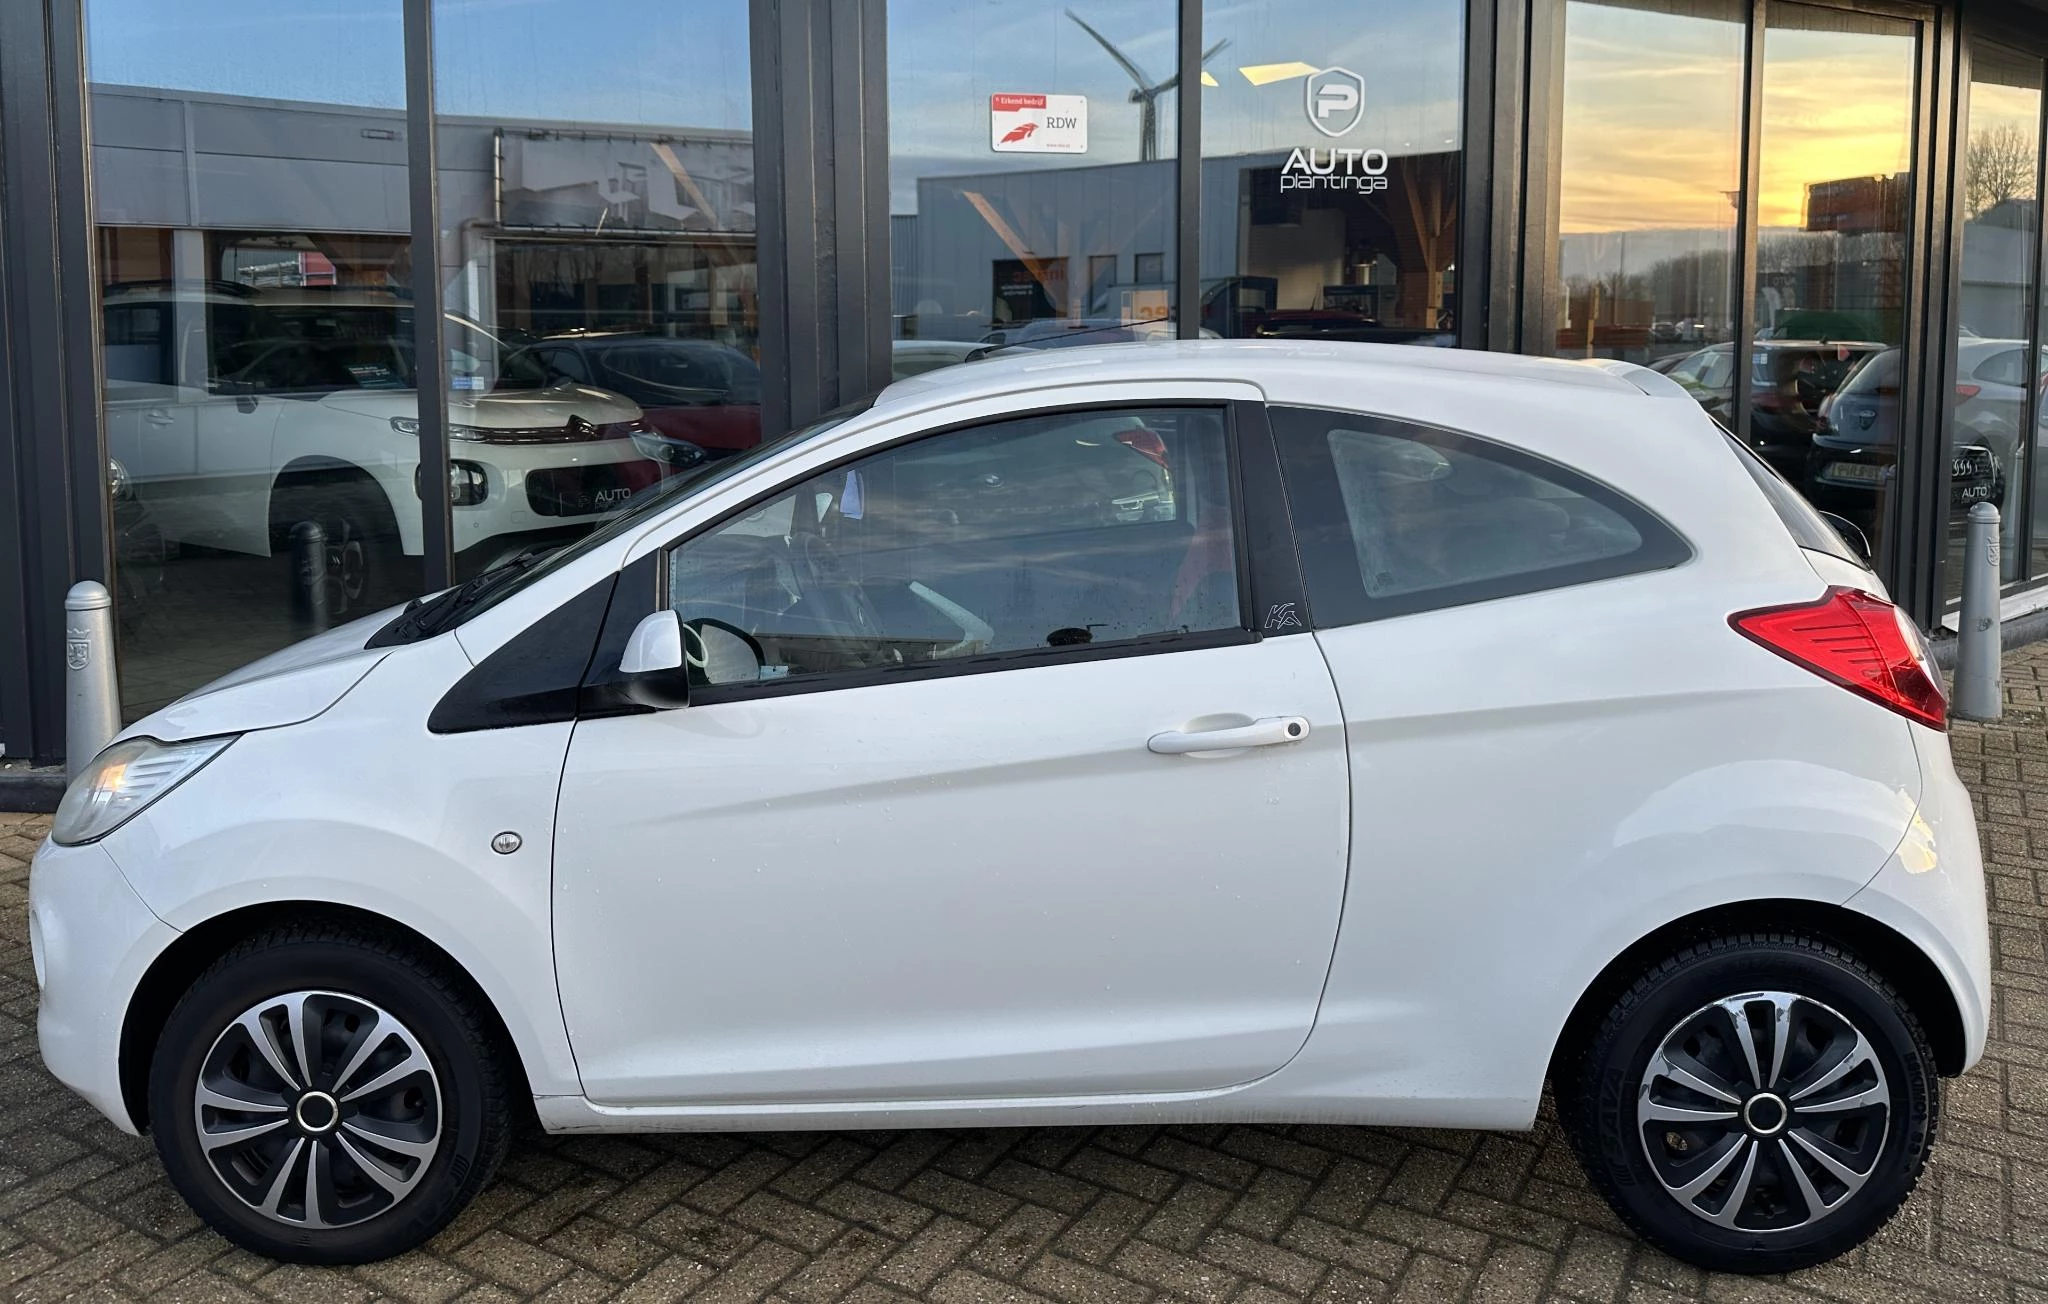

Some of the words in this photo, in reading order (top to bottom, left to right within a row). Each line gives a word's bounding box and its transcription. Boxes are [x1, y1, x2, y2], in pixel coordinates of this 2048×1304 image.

[1001, 96, 1023, 105] Erkend
[1317, 84, 1359, 118] P
[1046, 116, 1077, 129] RDW
[1281, 147, 1388, 175] AUTO
[1280, 172, 1388, 195] plantinga
[594, 487, 632, 503] AUTO
[1961, 486, 1988, 498] AUTO
